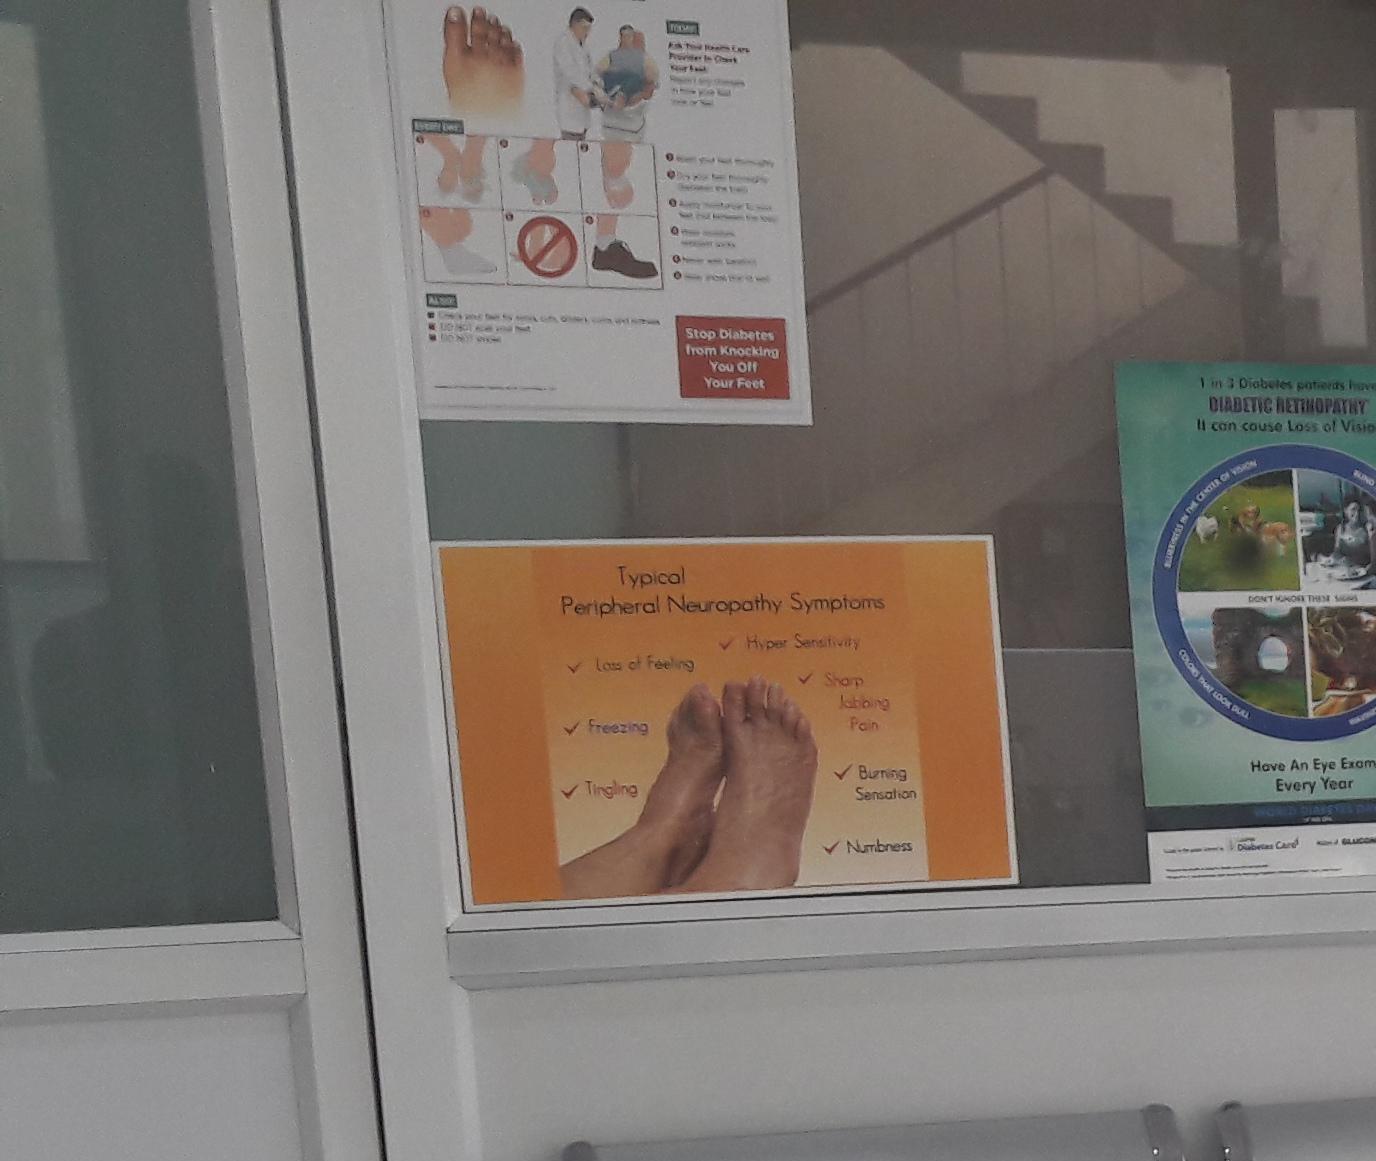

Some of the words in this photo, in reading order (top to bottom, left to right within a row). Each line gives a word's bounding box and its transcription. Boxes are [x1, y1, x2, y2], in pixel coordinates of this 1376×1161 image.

[685, 327, 717, 342] Stop
[719, 327, 775, 342] Diabetes
[685, 343, 718, 357] from
[720, 344, 781, 360] Knocking
[709, 360, 735, 373] You
[737, 360, 759, 373] Off
[704, 376, 734, 390] Your
[736, 377, 767, 390] Feet
[1238, 377, 1293, 390] Diabetes
[1209, 395, 1273, 415] DIABETIC
[1276, 395, 1368, 415] RETINOPATHY
[1211, 420, 1237, 432] can
[1242, 421, 1283, 433] cause
[1288, 419, 1322, 433] Loss
[1323, 419, 1337, 433] of
[617, 565, 686, 589] Typical
[561, 595, 660, 620] Peripheral
[667, 592, 784, 616] Neuropathy
[790, 591, 886, 615] Symptoms
[746, 634, 788, 651] Hyper
[794, 632, 861, 651] Sensitivity
[595, 656, 623, 673] Loss
[628, 657, 642, 672] of
[647, 655, 696, 673] Feeling
[825, 671, 865, 689] Sharp
[1212, 690, 1233, 710] LOOK
[1230, 703, 1252, 720] DULL
[850, 716, 880, 733] Pain
[858, 764, 908, 782] Burning
[1250, 758, 1286, 773] Have
[1290, 758, 1309, 772] An
[1313, 757, 1337, 775] Eye
[584, 778, 639, 800] Tingling
[855, 786, 918, 801] Sensation
[1275, 778, 1317, 795] Every
[1320, 776, 1355, 791] Year
[846, 838, 914, 854] Numbness
